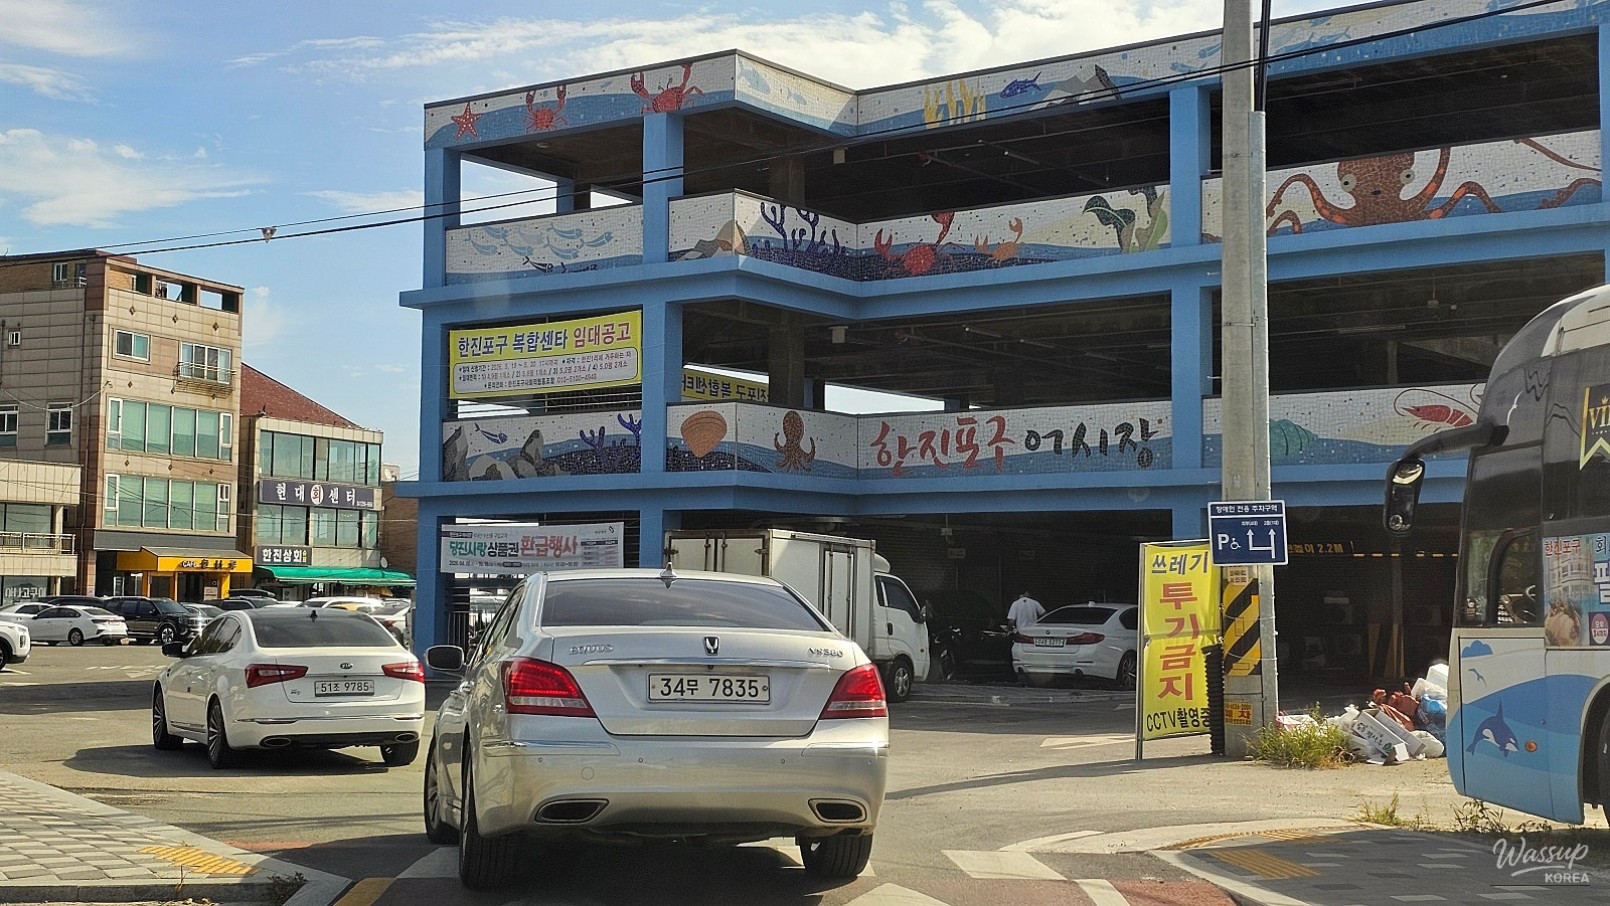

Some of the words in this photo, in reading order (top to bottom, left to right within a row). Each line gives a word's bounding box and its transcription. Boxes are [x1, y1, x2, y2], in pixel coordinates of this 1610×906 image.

[458, 334, 508, 358] 한진포구
[512, 329, 568, 353] 복합센타
[573, 322, 631, 348] 임대공고
[1589, 404, 1610, 429] VI
[870, 415, 1016, 477] 한진포구
[1024, 416, 1159, 469] 어시장
[1216, 506, 1235, 514] 장애인
[1237, 505, 1250, 513] 전용
[1252, 504, 1278, 512] 주차구역
[520, 535, 578, 559] 환급행사
[1218, 534, 1229, 550] P
[1544, 537, 1581, 557] 한진포구
[262, 548, 302, 563] 한진상회
[1152, 552, 1209, 575] 쓰레기
[1157, 582, 1199, 700] 투기금지
[321, 682, 340, 693] 51조
[344, 682, 369, 692] 9785
[660, 678, 699, 697] 34무
[709, 678, 759, 698] 7835
